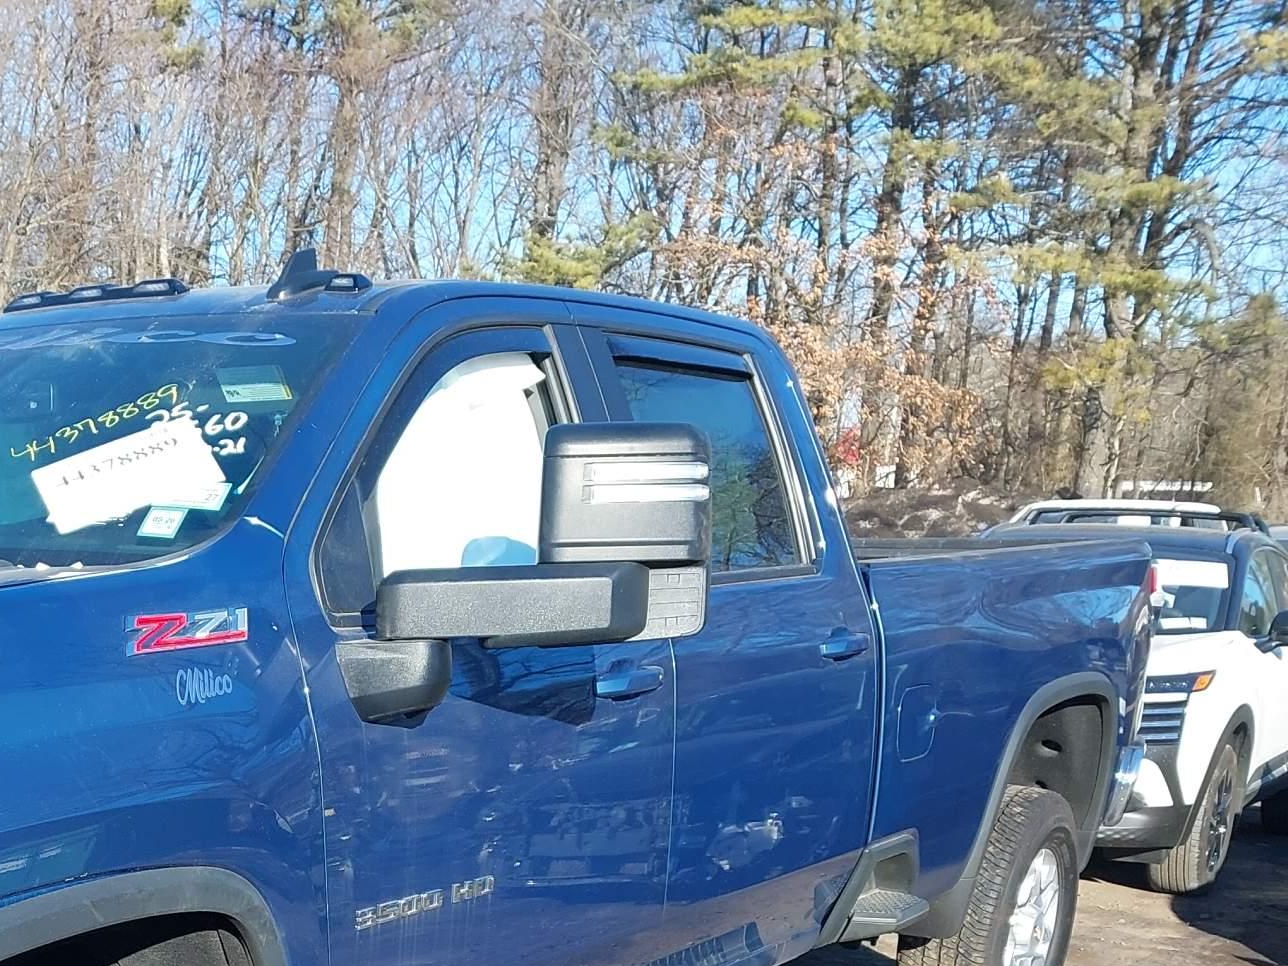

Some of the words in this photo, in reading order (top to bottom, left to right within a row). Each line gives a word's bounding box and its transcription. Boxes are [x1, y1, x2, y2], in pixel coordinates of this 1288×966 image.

[10, 383, 179, 462] 44378889
[123, 606, 249, 657] Z71
[354, 888, 444, 931] 3500
[450, 874, 495, 905] HD
